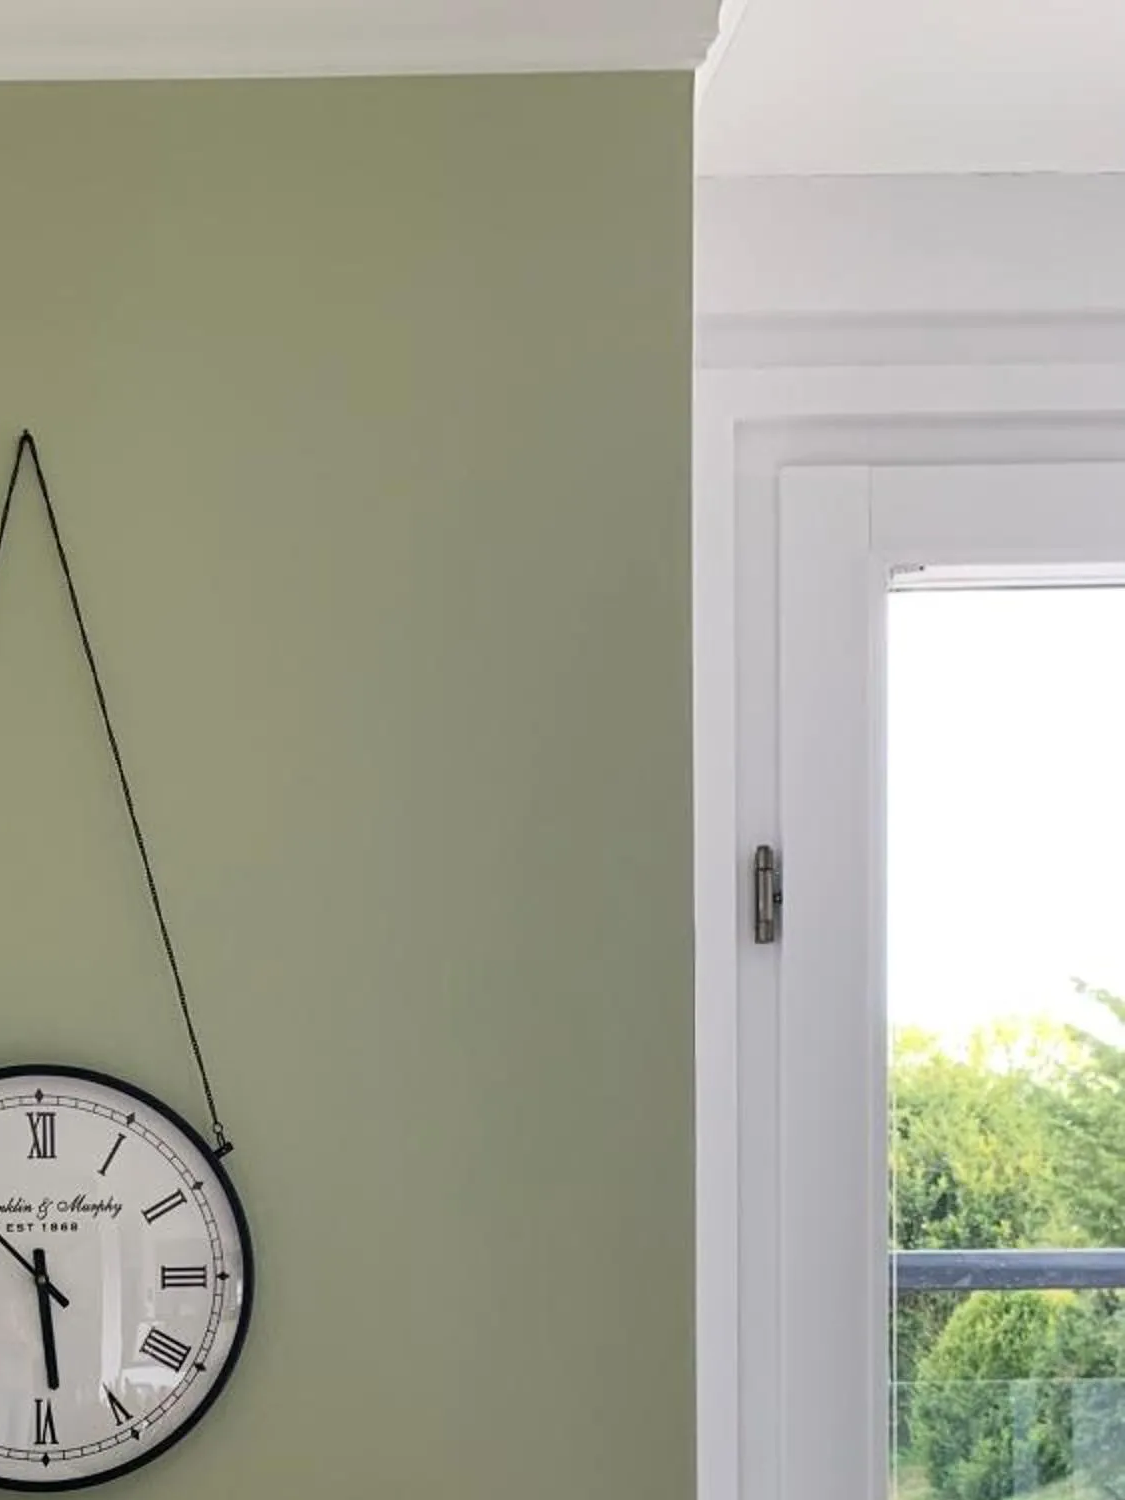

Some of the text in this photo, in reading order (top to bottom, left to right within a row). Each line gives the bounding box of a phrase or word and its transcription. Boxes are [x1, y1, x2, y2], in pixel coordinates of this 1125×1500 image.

[27, 1112, 56, 1159] XII
[97, 1133, 126, 1176] I
[37, 1197, 53, 1220] &
[57, 1193, 123, 1219] Murphy
[141, 1188, 187, 1225] II
[6, 1223, 34, 1232] EST
[160, 1264, 207, 1289] III
[34, 1399, 59, 1445] VI
[103, 1384, 134, 1427] V
